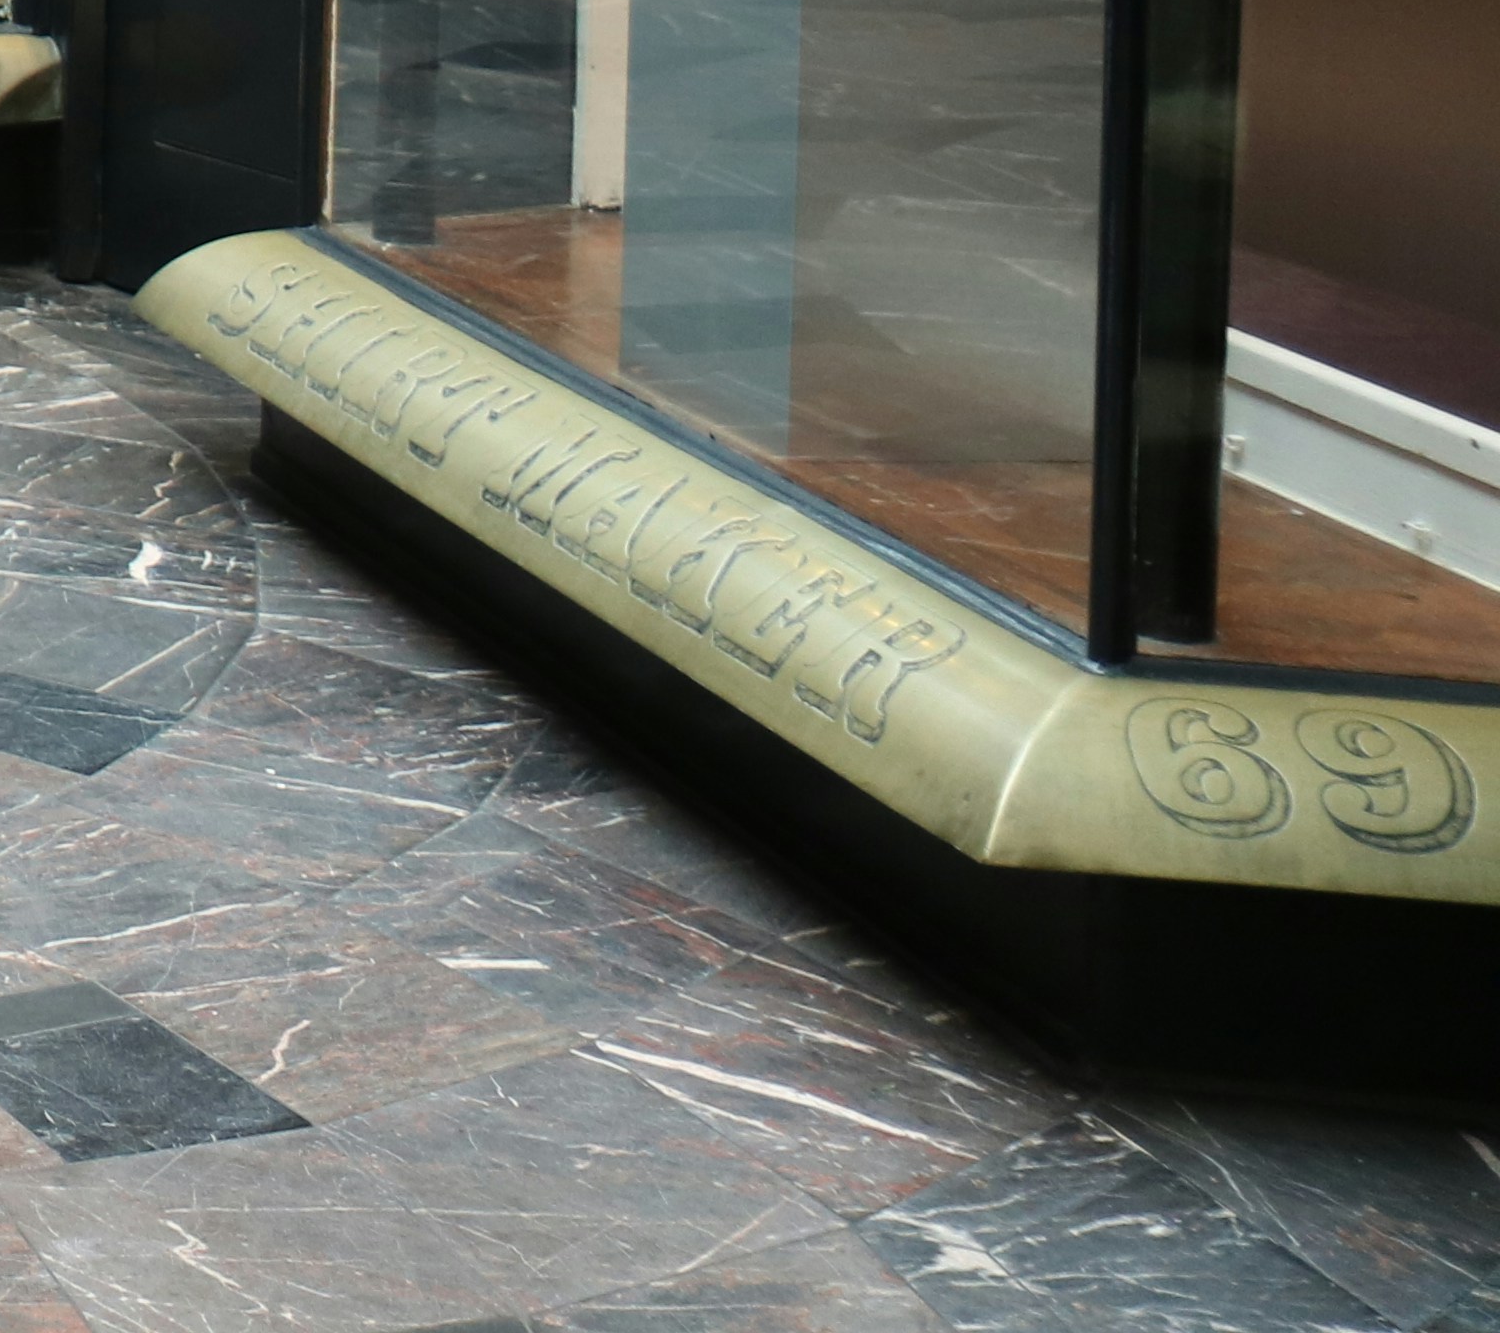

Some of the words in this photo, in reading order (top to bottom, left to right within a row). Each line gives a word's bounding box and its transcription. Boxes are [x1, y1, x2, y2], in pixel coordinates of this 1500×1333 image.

[206, 260, 538, 469] SHIRT
[481, 413, 966, 749] MAKER
[1123, 695, 1479, 857] 69
